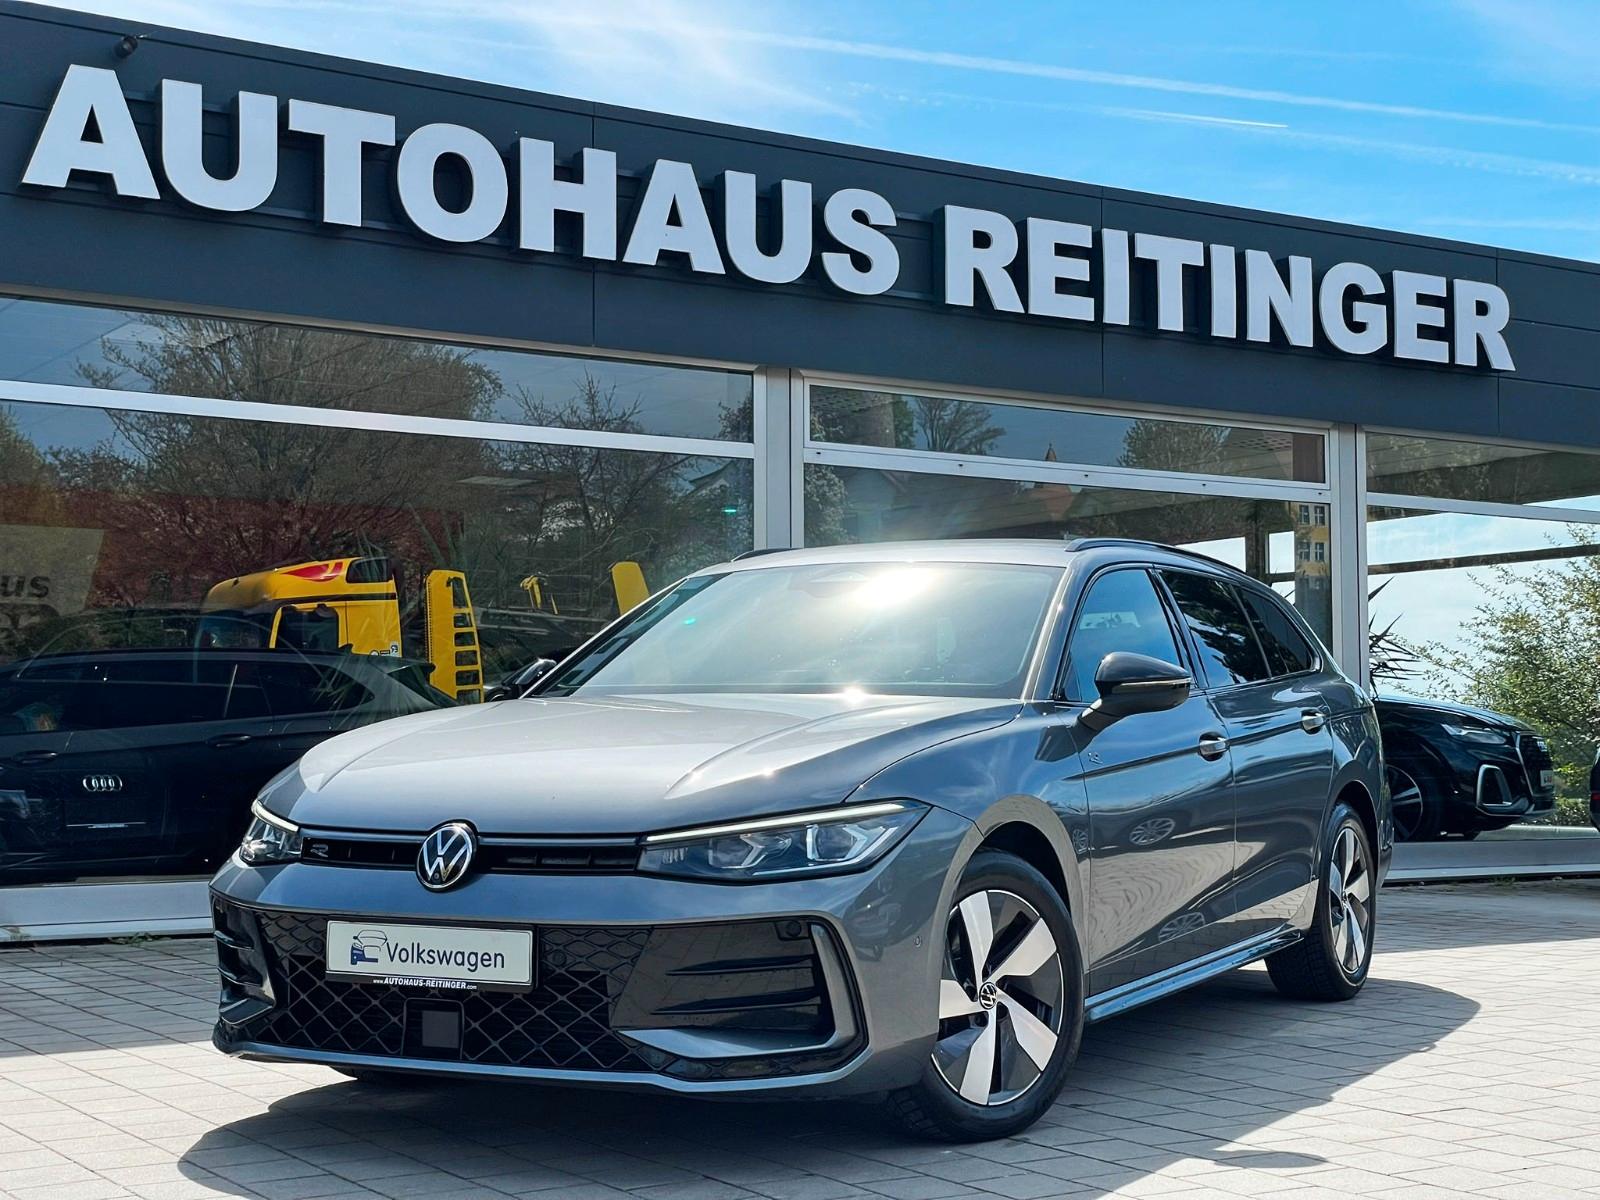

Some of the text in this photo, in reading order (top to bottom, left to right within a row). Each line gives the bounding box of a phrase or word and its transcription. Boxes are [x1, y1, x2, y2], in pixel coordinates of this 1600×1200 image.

[21, 64, 1517, 372] AUTOHAUS REITINGER
[386, 942, 505, 973] Volkswagen
